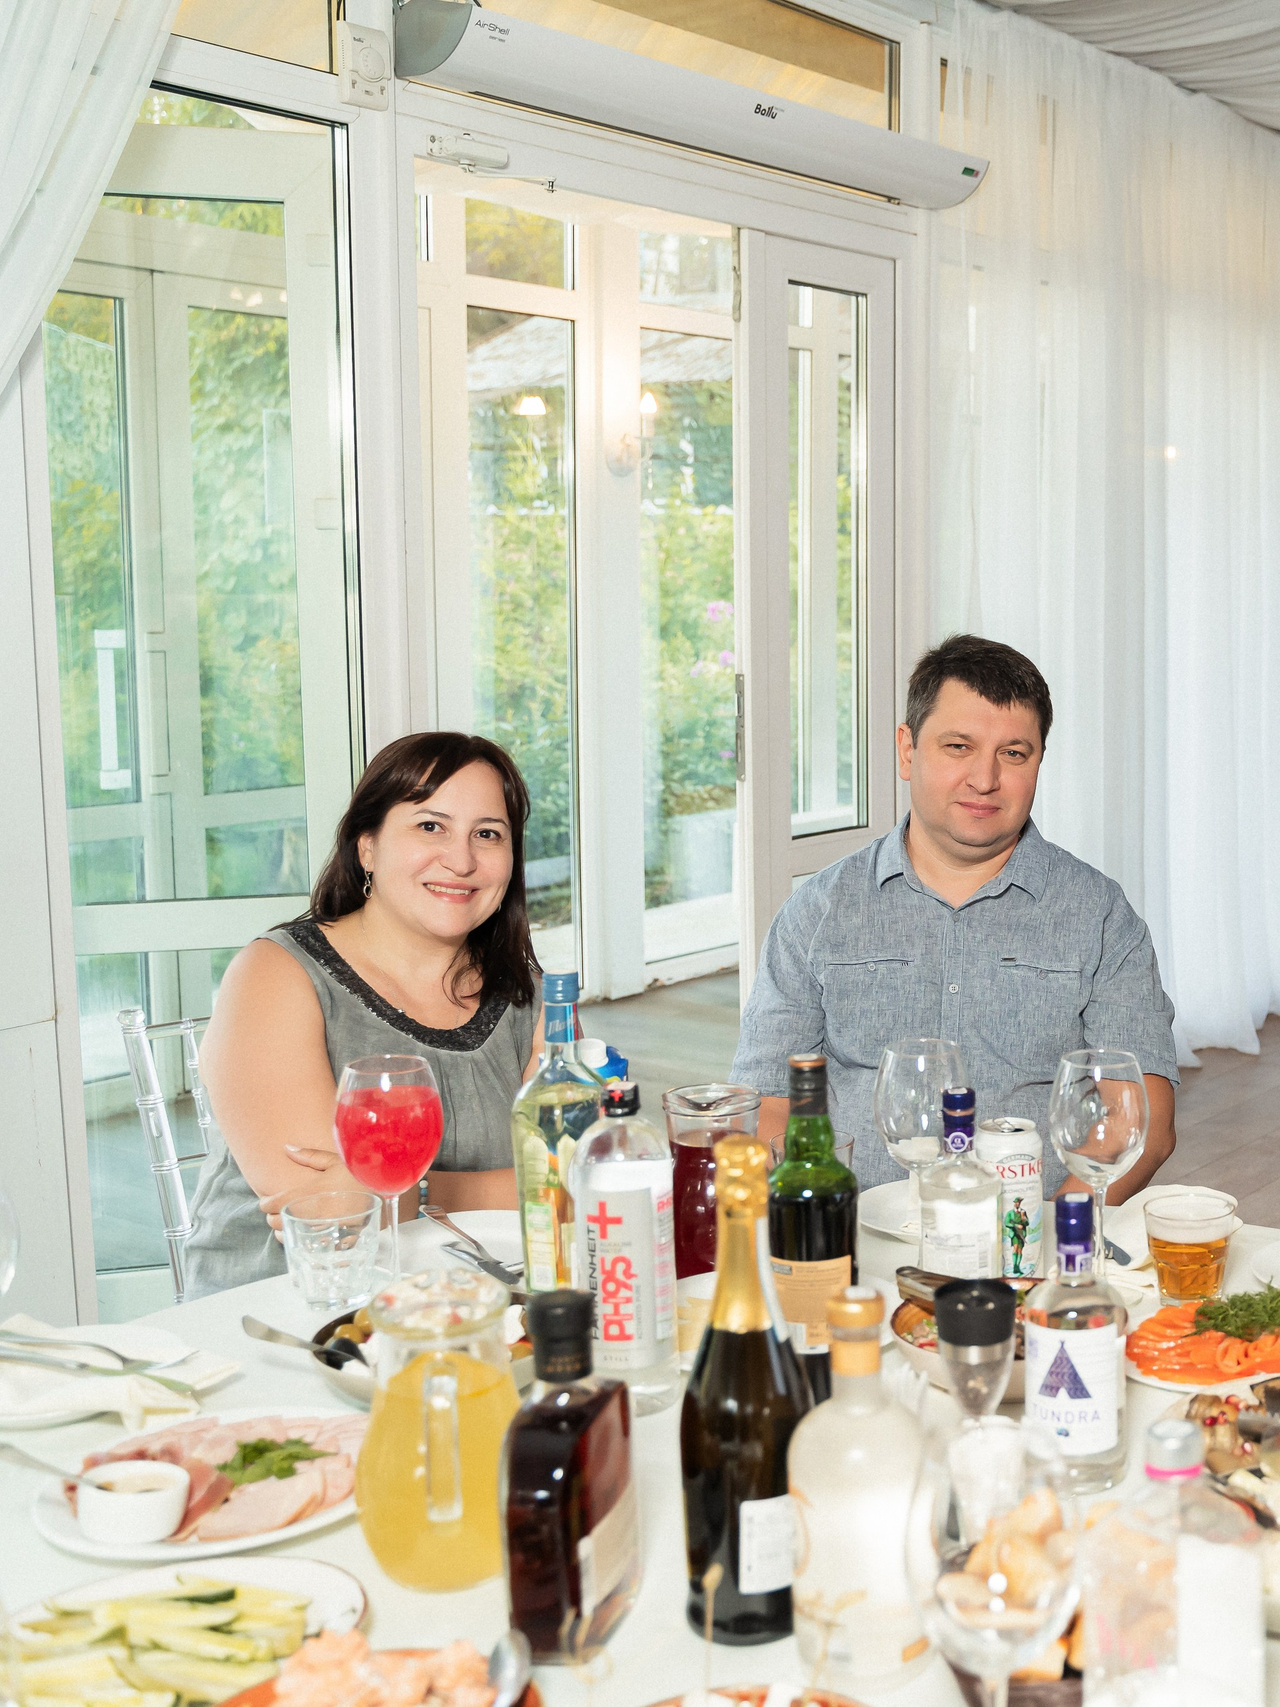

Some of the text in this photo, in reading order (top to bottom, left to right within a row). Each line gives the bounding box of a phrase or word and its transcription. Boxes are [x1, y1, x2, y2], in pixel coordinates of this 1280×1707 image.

[474, 19, 511, 36] AirShell
[754, 103, 778, 120] Ballu
[1032, 1403, 1102, 1425] TUNDRA
